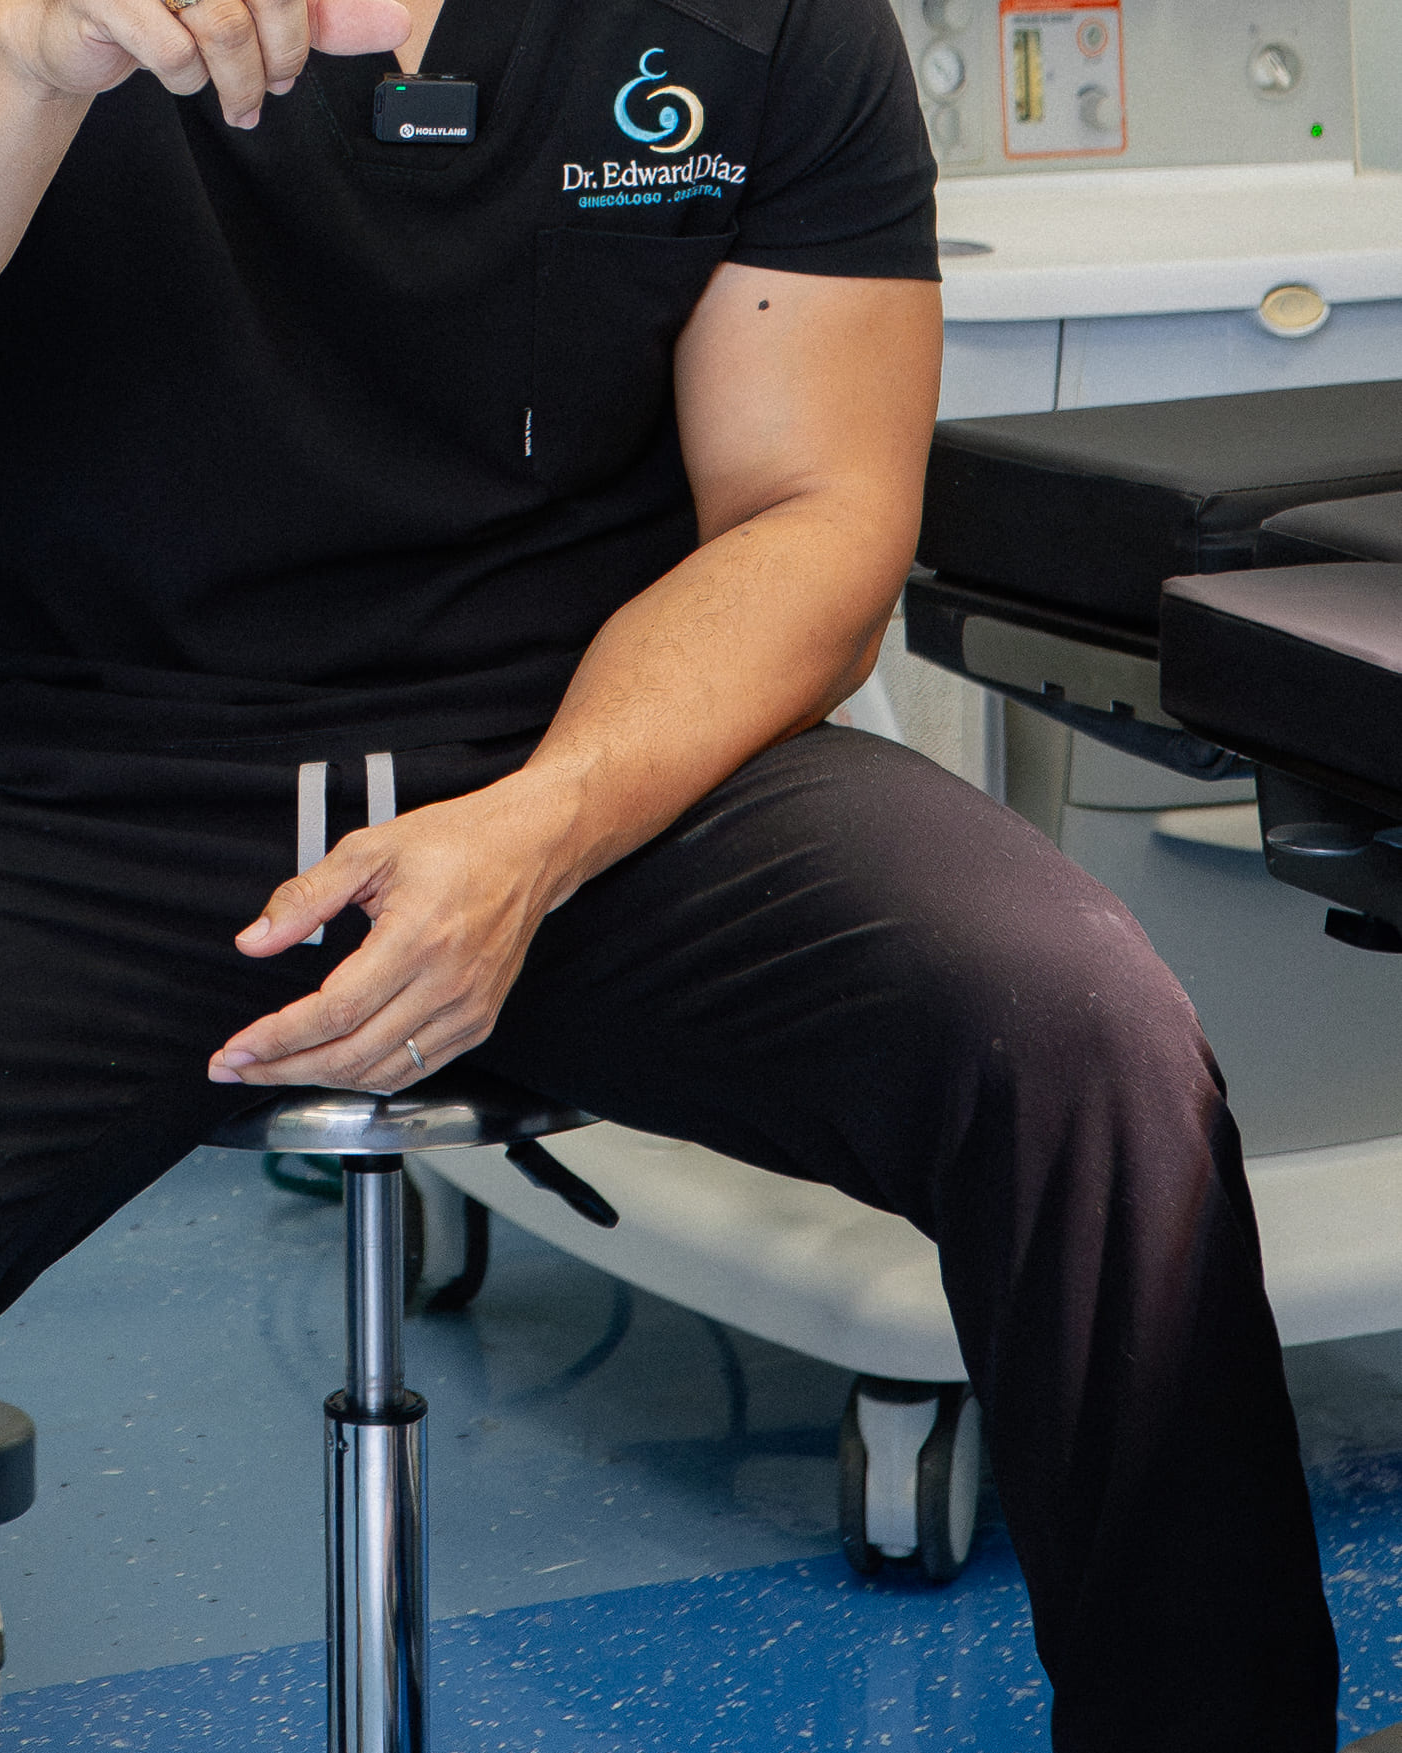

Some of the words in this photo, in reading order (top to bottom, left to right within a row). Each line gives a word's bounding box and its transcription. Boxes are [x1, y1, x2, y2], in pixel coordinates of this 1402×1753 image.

[415, 126, 468, 137] HOLLYLAND
[562, 163, 598, 191] Dr.
[602, 155, 696, 190] Edward
[694, 153, 747, 185] Díaz
[578, 190, 662, 208] GINECÓLOGO
